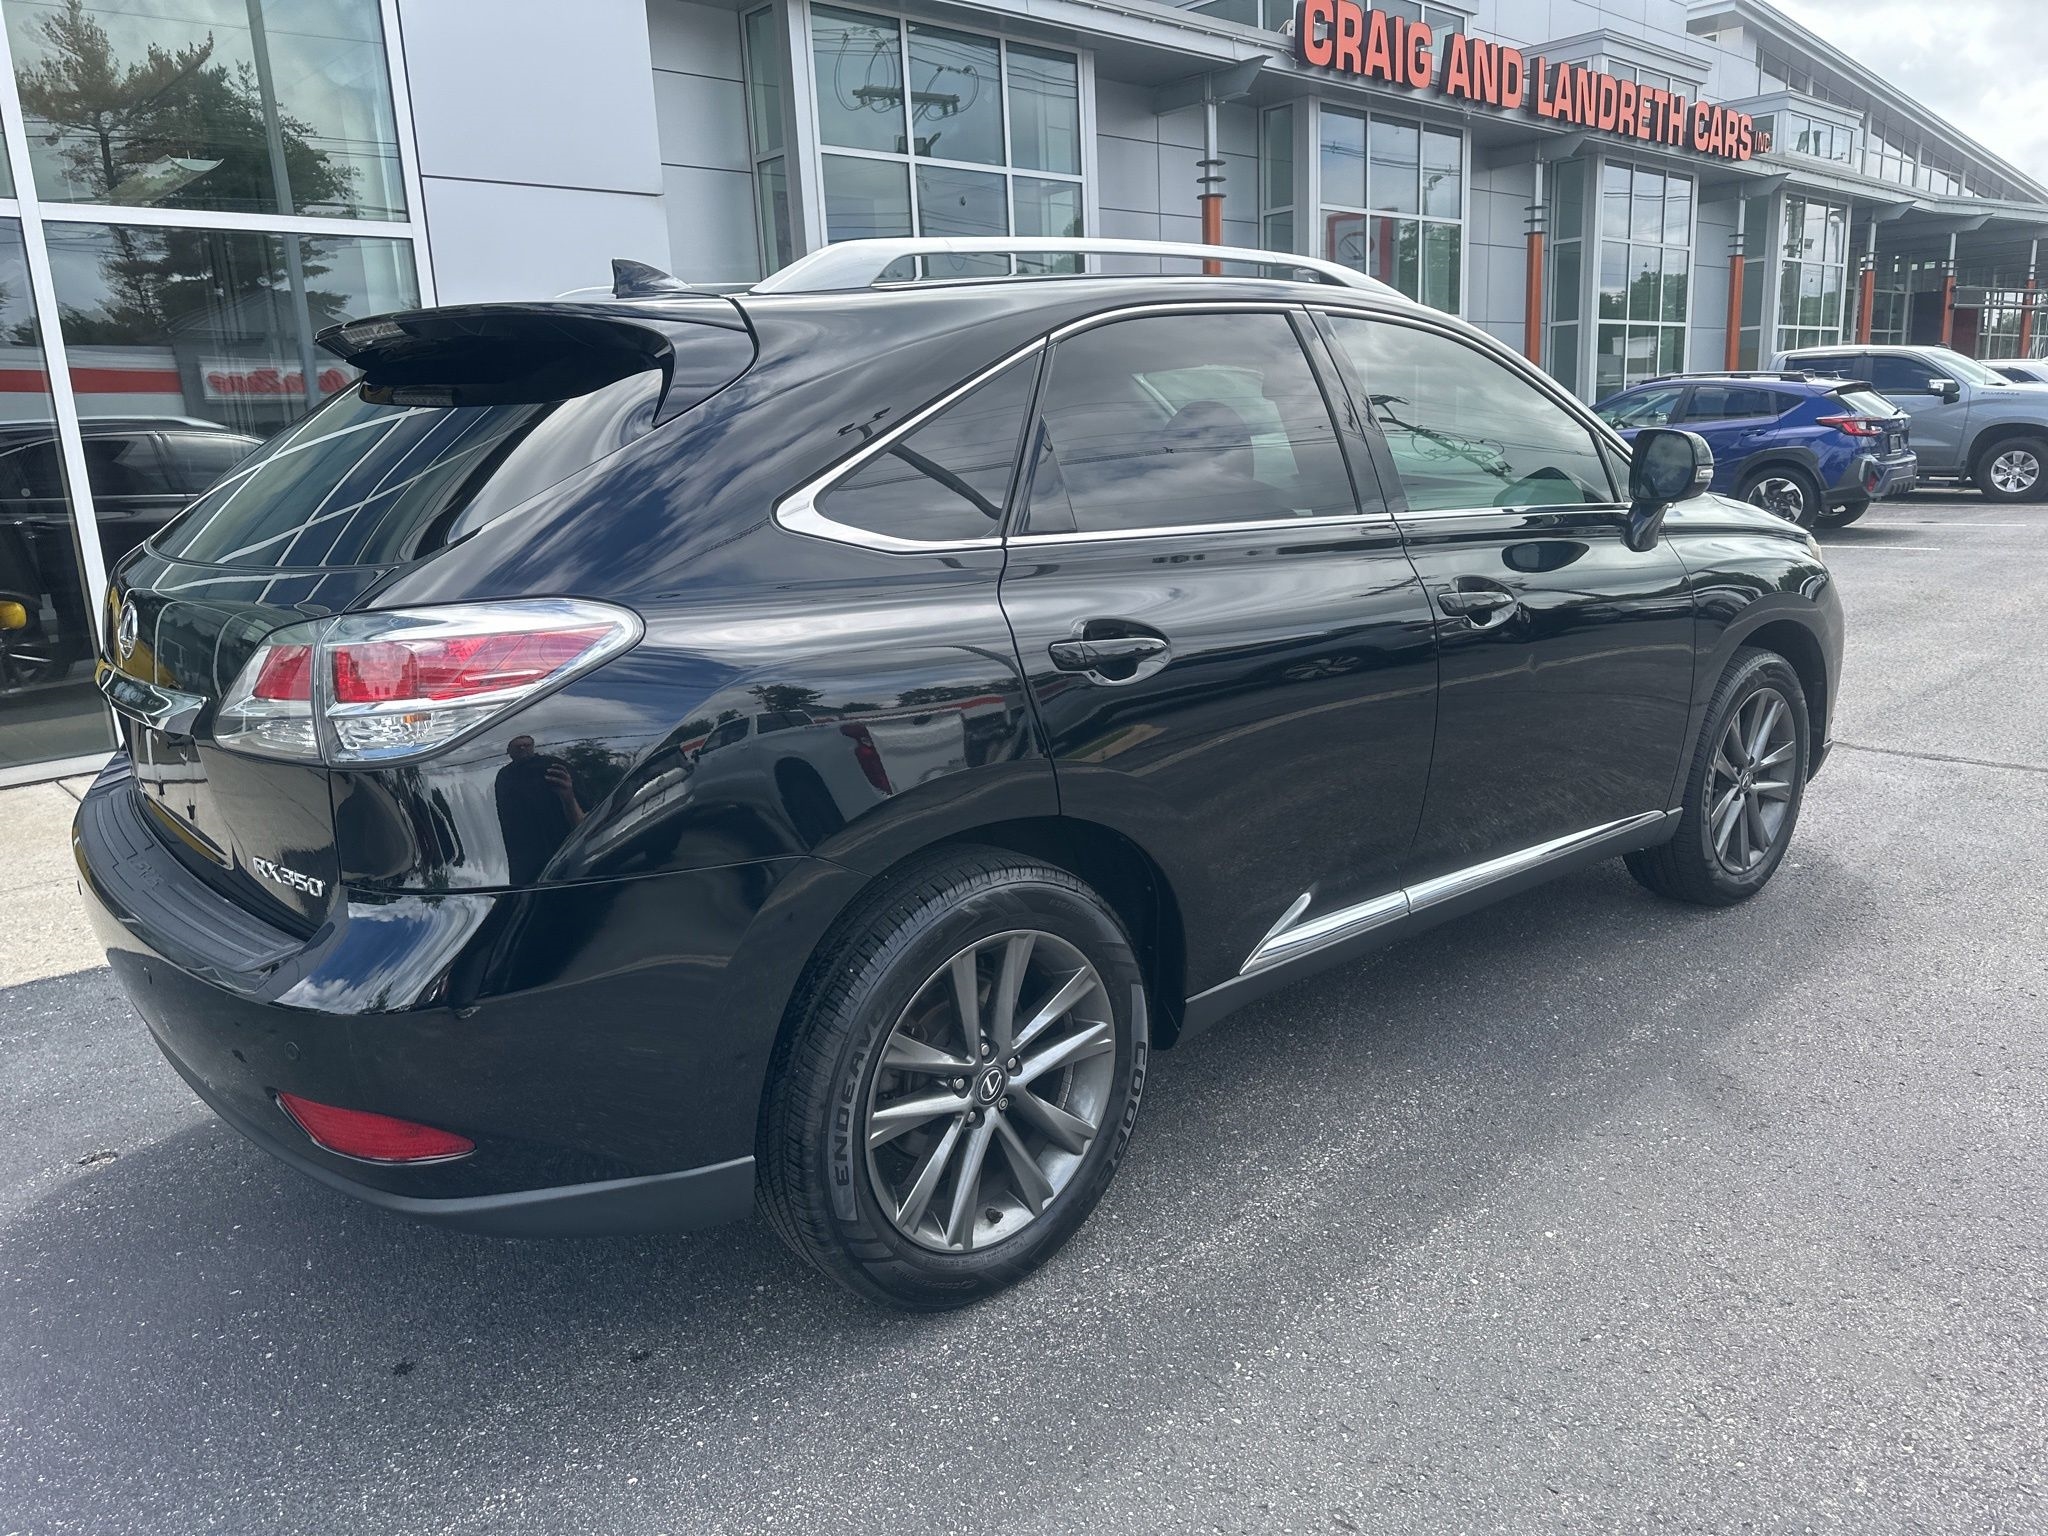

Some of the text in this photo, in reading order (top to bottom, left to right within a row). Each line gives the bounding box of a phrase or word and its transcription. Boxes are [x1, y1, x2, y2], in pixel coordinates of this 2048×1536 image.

[1303, 0, 1433, 89] CRAIG
[1446, 32, 1525, 109] AND
[1537, 56, 1687, 146] LANDRETH
[1694, 100, 1754, 161] CARS
